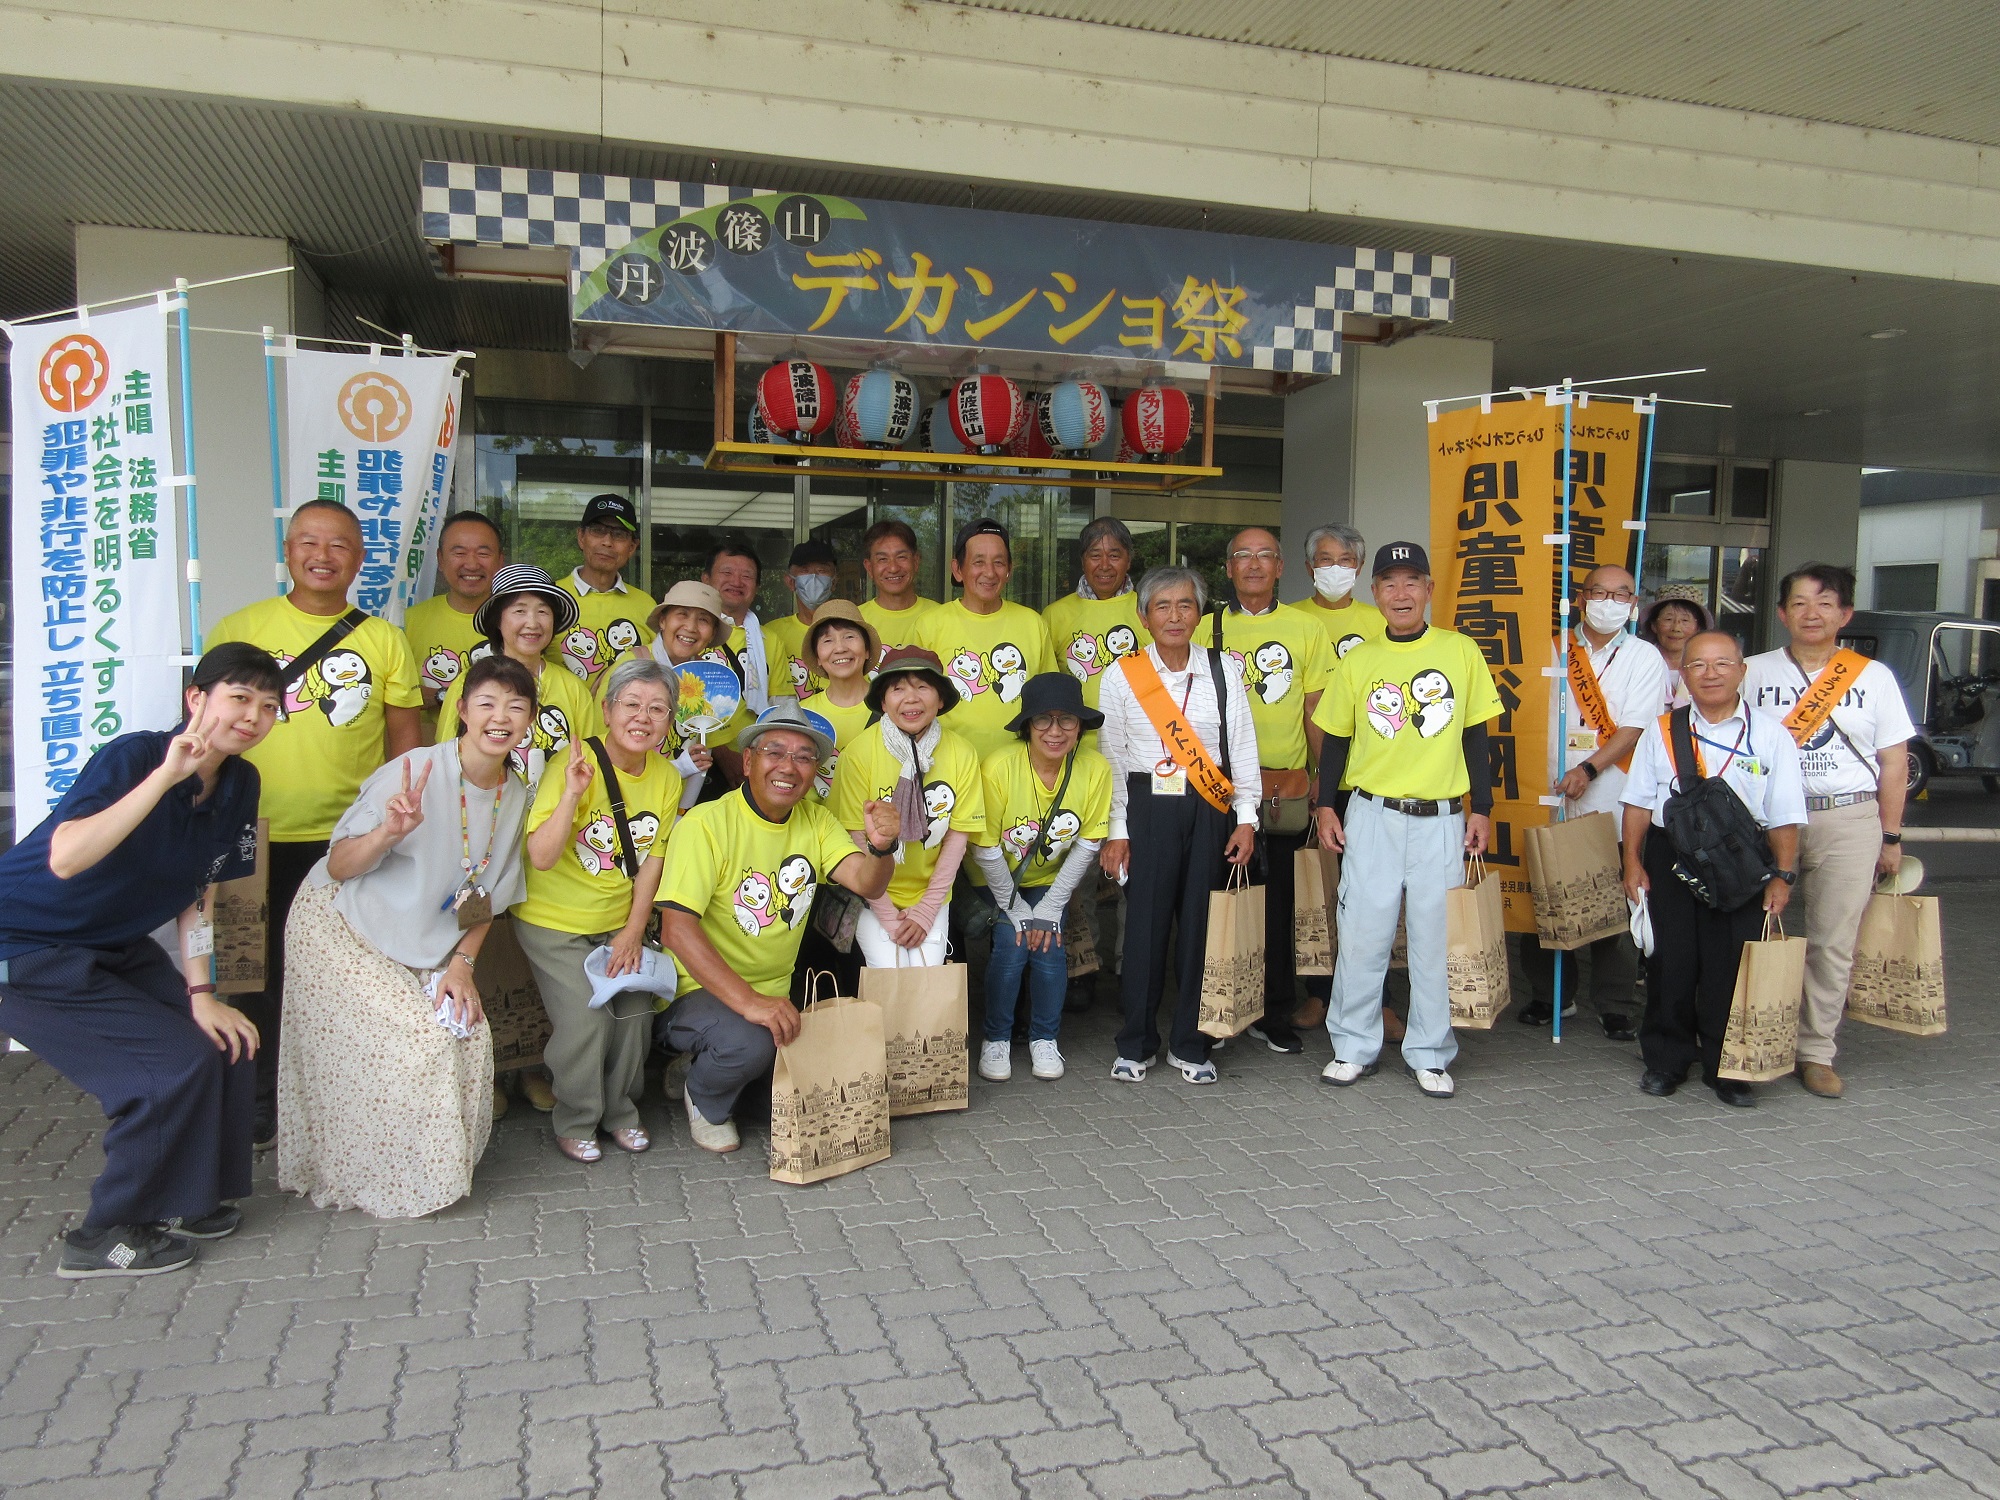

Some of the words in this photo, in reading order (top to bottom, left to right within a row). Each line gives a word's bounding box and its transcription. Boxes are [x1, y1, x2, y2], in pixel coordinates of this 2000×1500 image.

[615, 208, 821, 303] 丹波篠山
[792, 249, 1250, 362] デカンショ祭
[123, 369, 154, 435] 主唱
[791, 362, 817, 418] 丹波篠山
[887, 380, 912, 439] 丹波篠山
[960, 381, 984, 437] 丹波篠山
[1079, 382, 1106, 443] デカンショ祭
[1141, 389, 1165, 448] デカンショ祭
[127, 457, 158, 560] 法務省
[1757, 686, 1806, 707] FLY
[41, 661, 85, 811] 立ち直りを
